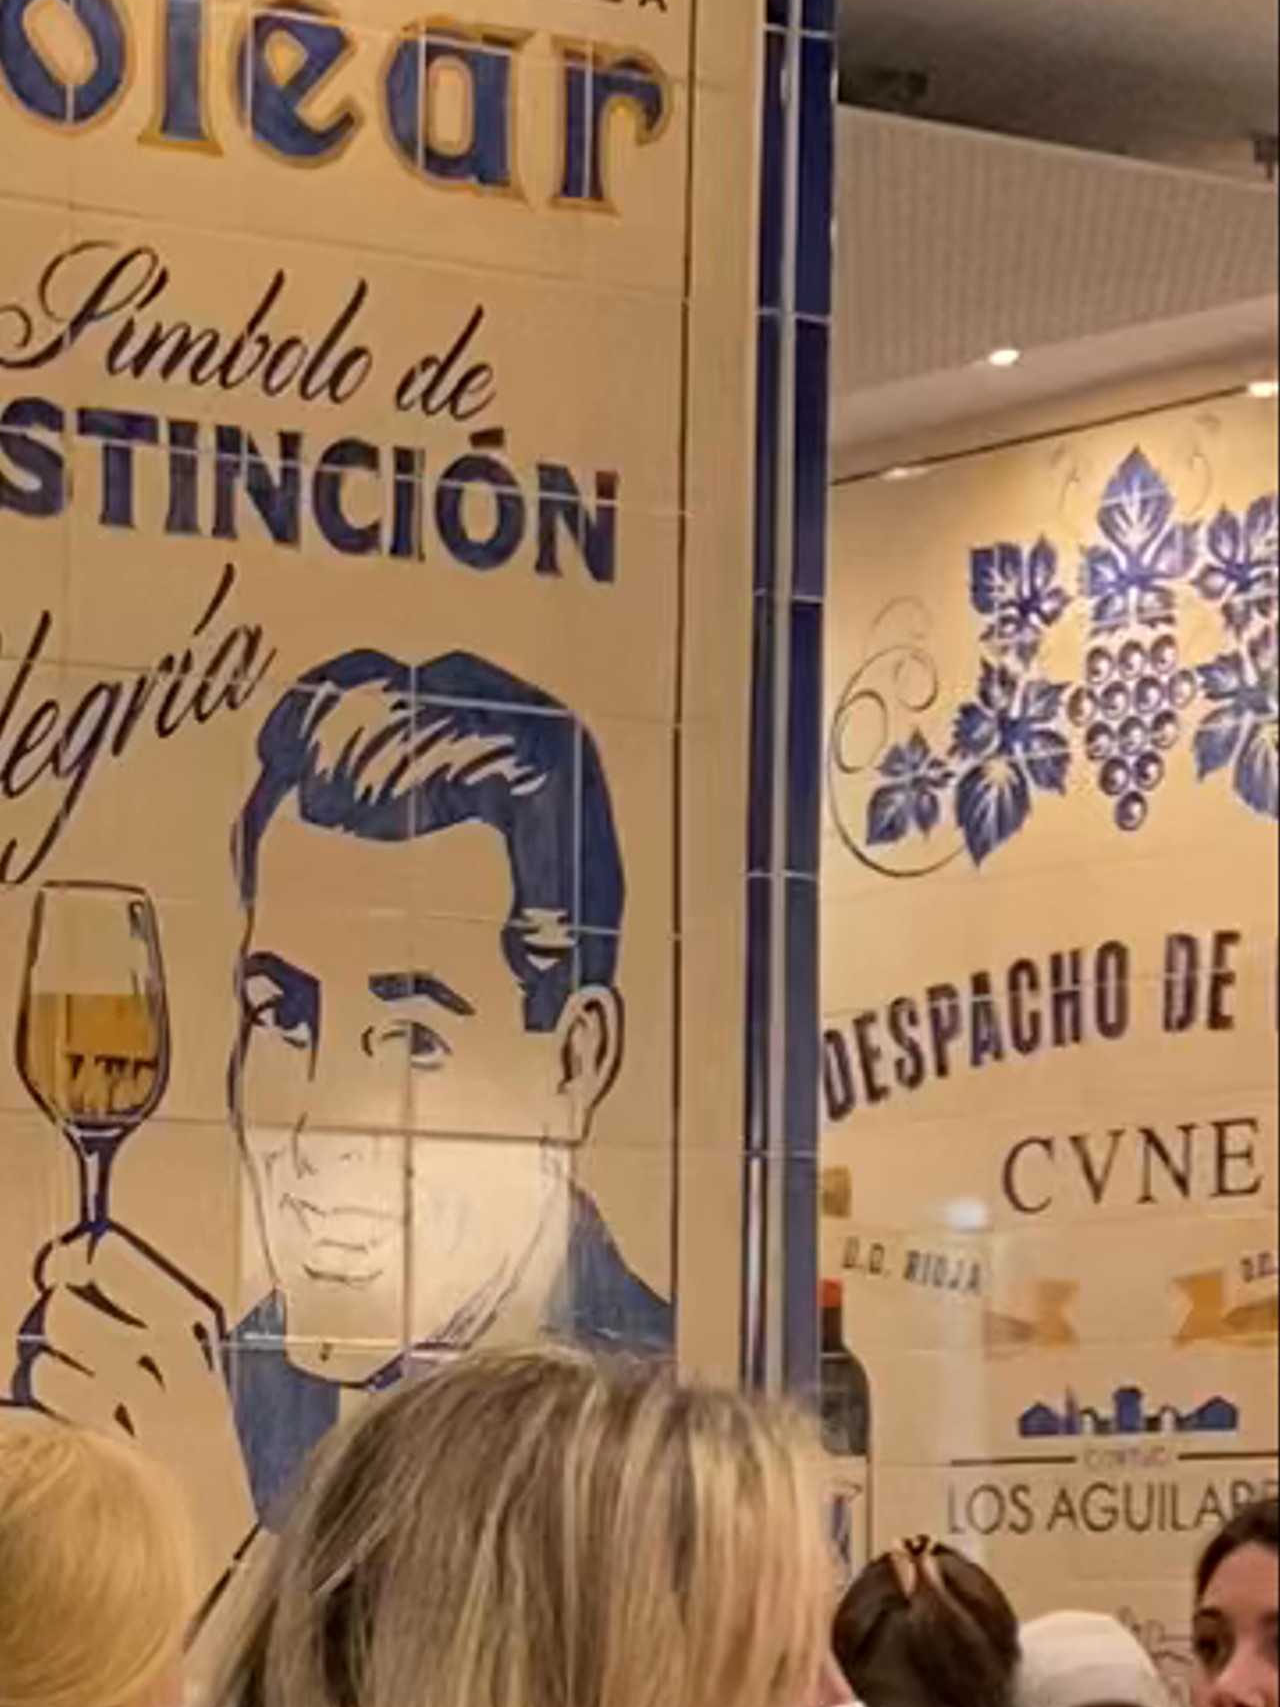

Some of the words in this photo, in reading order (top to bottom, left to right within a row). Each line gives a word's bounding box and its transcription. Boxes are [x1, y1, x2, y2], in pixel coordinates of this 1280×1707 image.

[394, 304, 497, 422] de
[822, 939, 1131, 1122] DESPACHO
[1163, 930, 1241, 1033] DE
[1001, 1116, 1264, 1214] CVNE
[903, 1249, 982, 1297] RIOJA
[947, 1480, 1034, 1535] LOS
